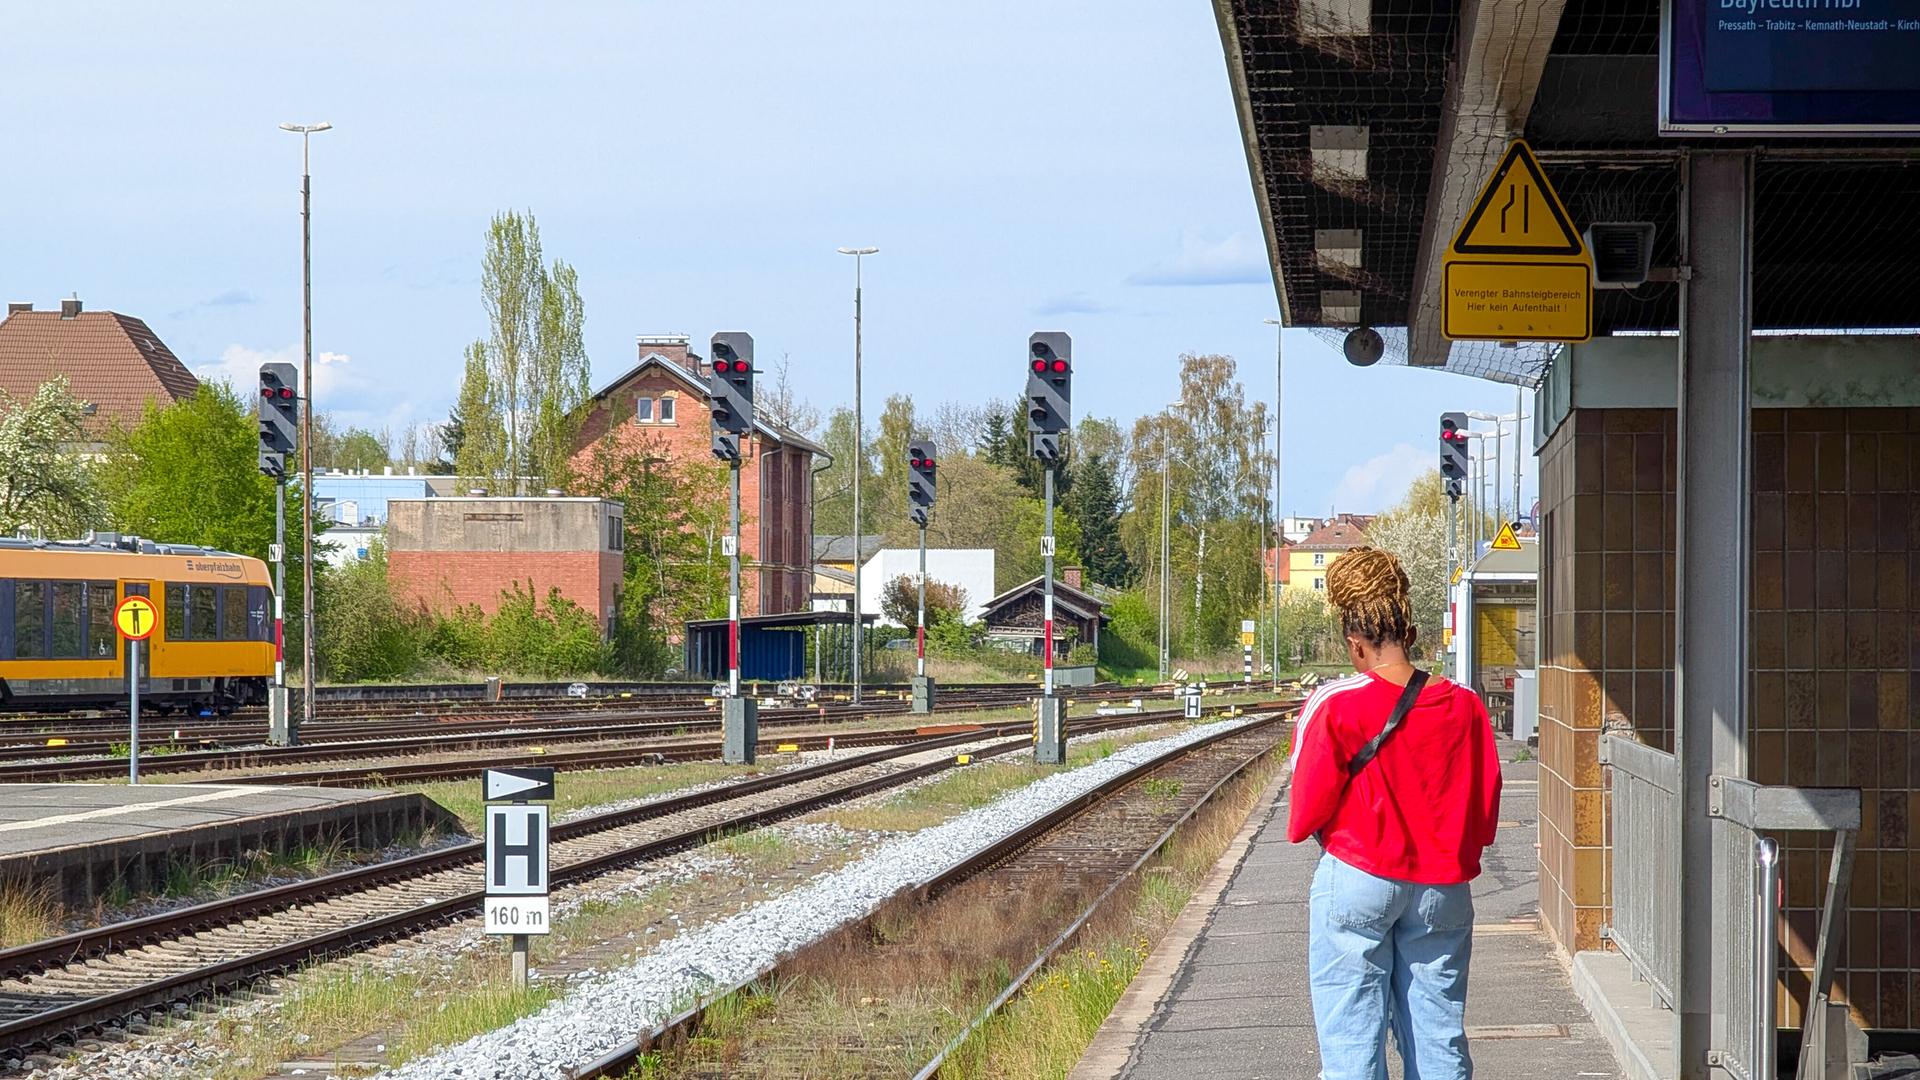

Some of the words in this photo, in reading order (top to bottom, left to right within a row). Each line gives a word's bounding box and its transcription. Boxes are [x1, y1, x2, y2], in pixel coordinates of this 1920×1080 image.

[1718, 20, 1756, 30] Pressath
[1765, 20, 1796, 30] Trabitz
[1805, 20, 1888, 30] Kemnath-Neustadt
[1455, 288, 1499, 299] Verengter
[1502, 289, 1581, 300] Bahnsteigbereich
[1467, 302, 1486, 311] Hier
[1489, 303, 1509, 312] kein
[1512, 303, 1561, 313] Aufenthalt
[269, 545, 281, 560] N7
[1187, 697, 1199, 716] H
[493, 812, 540, 887] H
[490, 906, 519, 926] 160
